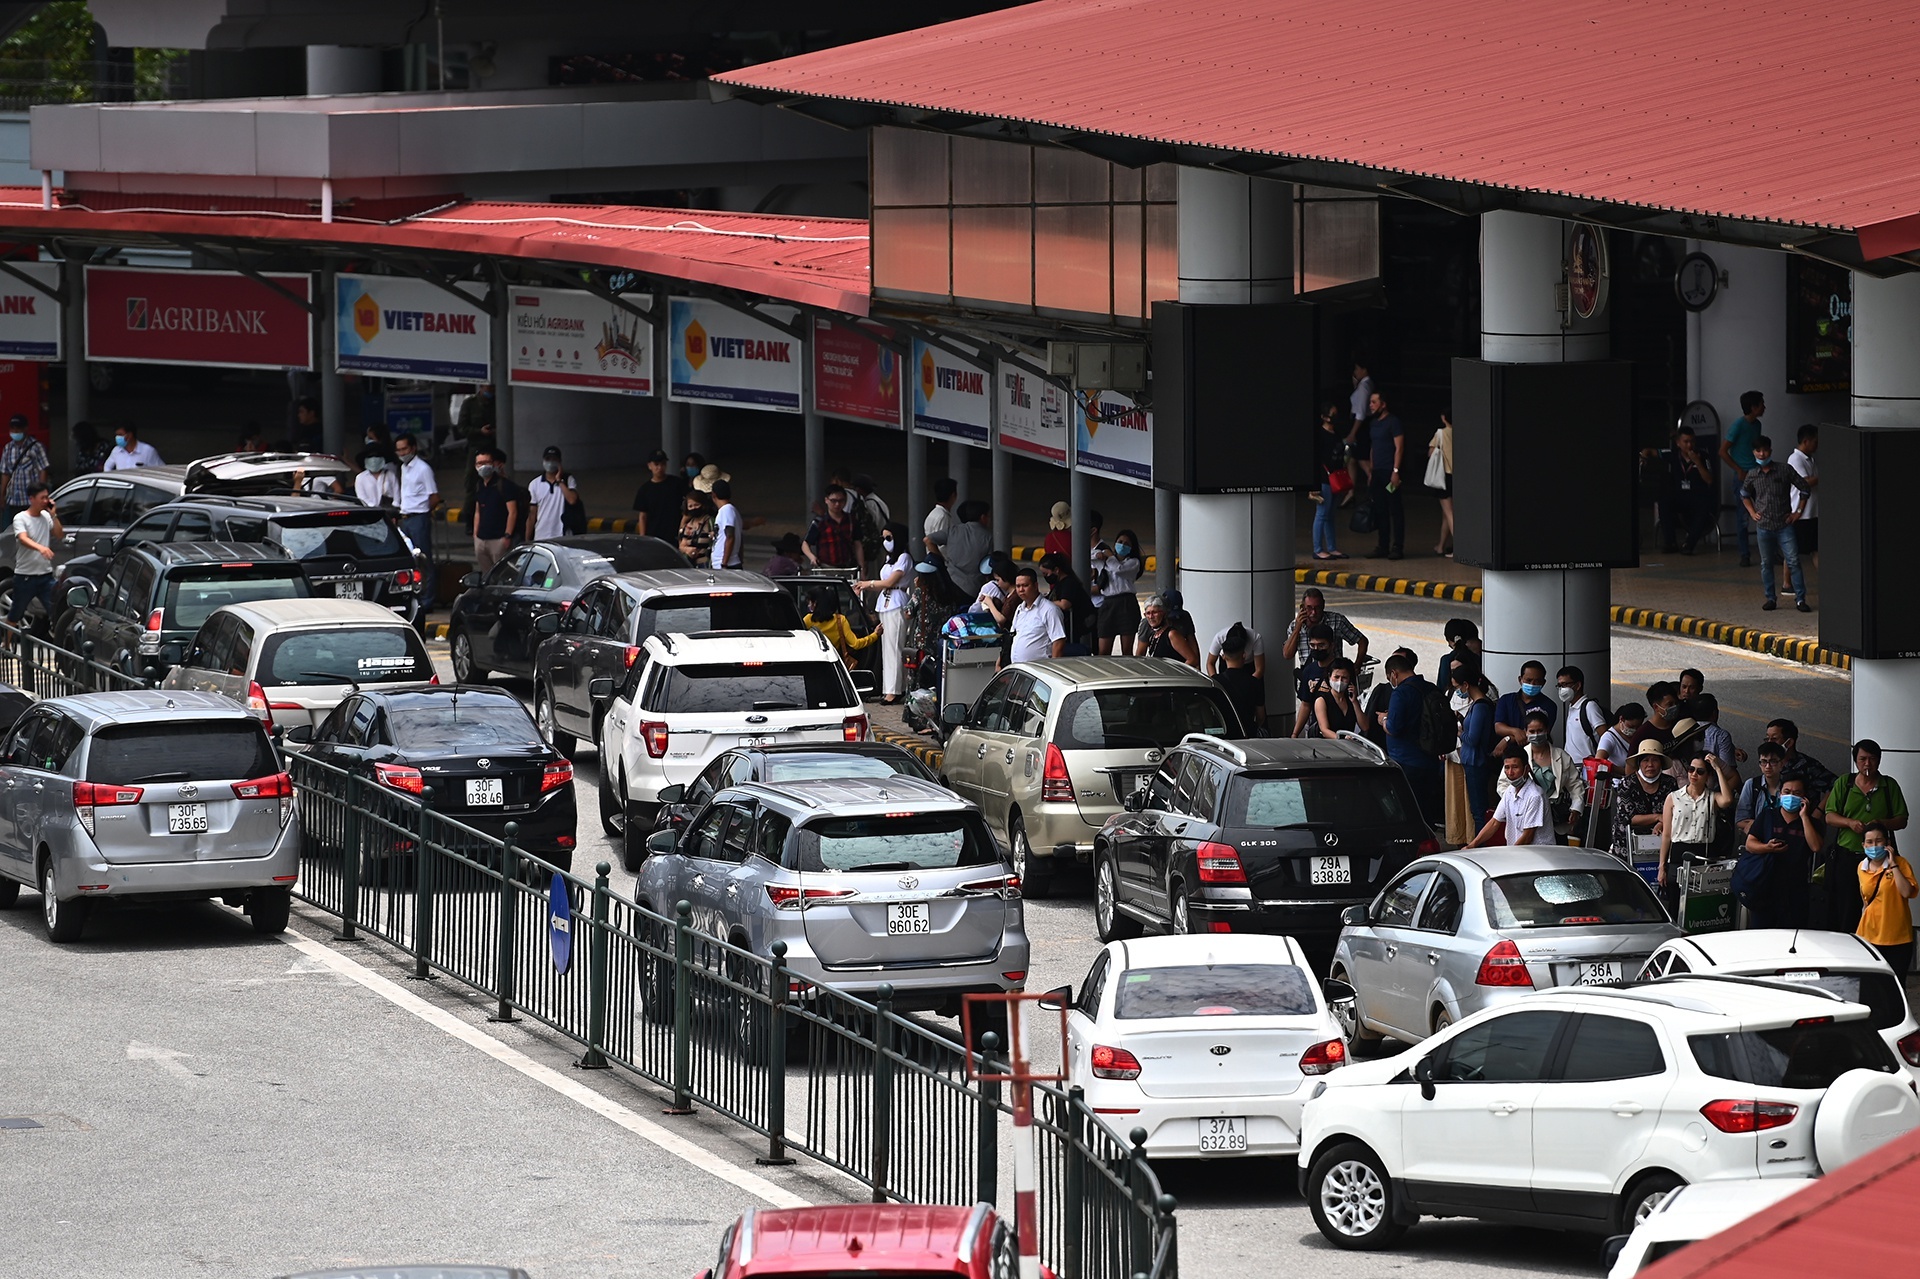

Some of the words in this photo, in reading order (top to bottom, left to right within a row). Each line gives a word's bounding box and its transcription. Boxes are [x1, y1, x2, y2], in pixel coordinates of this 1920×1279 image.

[0, 295, 36, 315] NK
[150, 306, 268, 335] AGRIBANK
[383, 309, 477, 335] VIETBANK
[547, 316, 585, 332] AGRIBANK
[710, 336, 791, 363] VIETBANK
[936, 366, 984, 396] VIETBANK
[1691, 414, 1707, 425] NIA
[341, 582, 358, 593] 30A
[474, 779, 494, 792] 30F
[467, 792, 503, 805] 038.46
[177, 804, 197, 817] 30F
[170, 816, 207, 831] 735.65
[1319, 857, 1341, 870] 29A
[1312, 870, 1350, 884] 338.82
[1707, 877, 1732, 886] Vietcomb
[897, 904, 920, 919] 30E
[889, 919, 929, 934] 960.62
[1688, 915, 1732, 929] Vietcombank
[1589, 963, 1613, 977] 36A
[1212, 1046, 1228, 1055] KIA
[1210, 1119, 1235, 1135] 37A
[1200, 1134, 1245, 1150] 632.89
